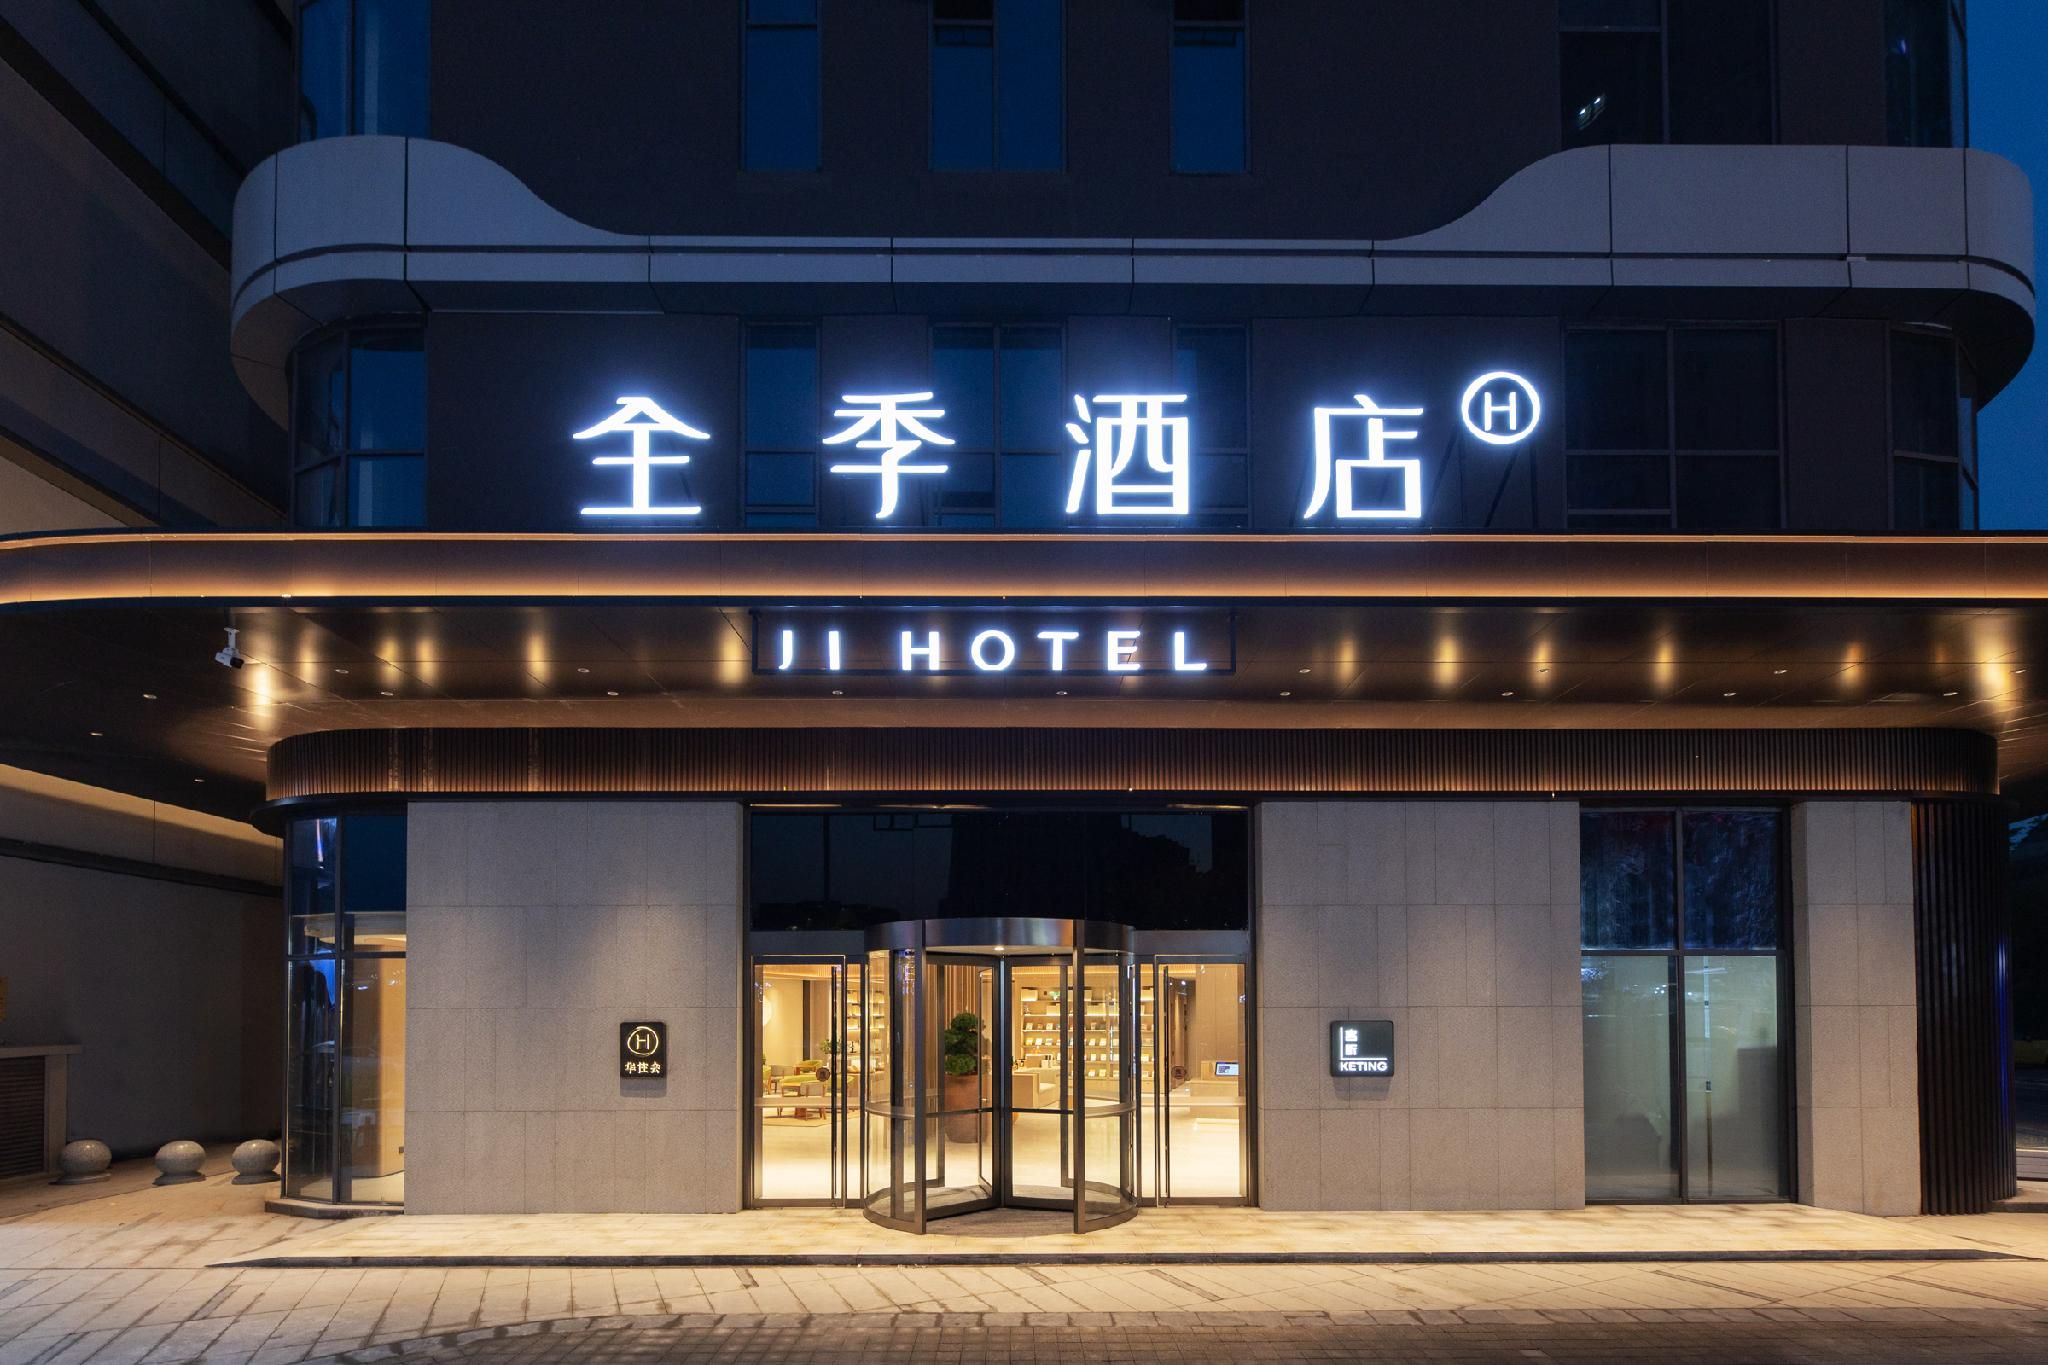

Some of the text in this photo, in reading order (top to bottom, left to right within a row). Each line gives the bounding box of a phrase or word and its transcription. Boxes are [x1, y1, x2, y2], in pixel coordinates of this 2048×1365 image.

[572, 391, 1424, 519] 全季酒店
[778, 629, 1208, 671] JI HOTEL
[1340, 1061, 1388, 1072] KETING
